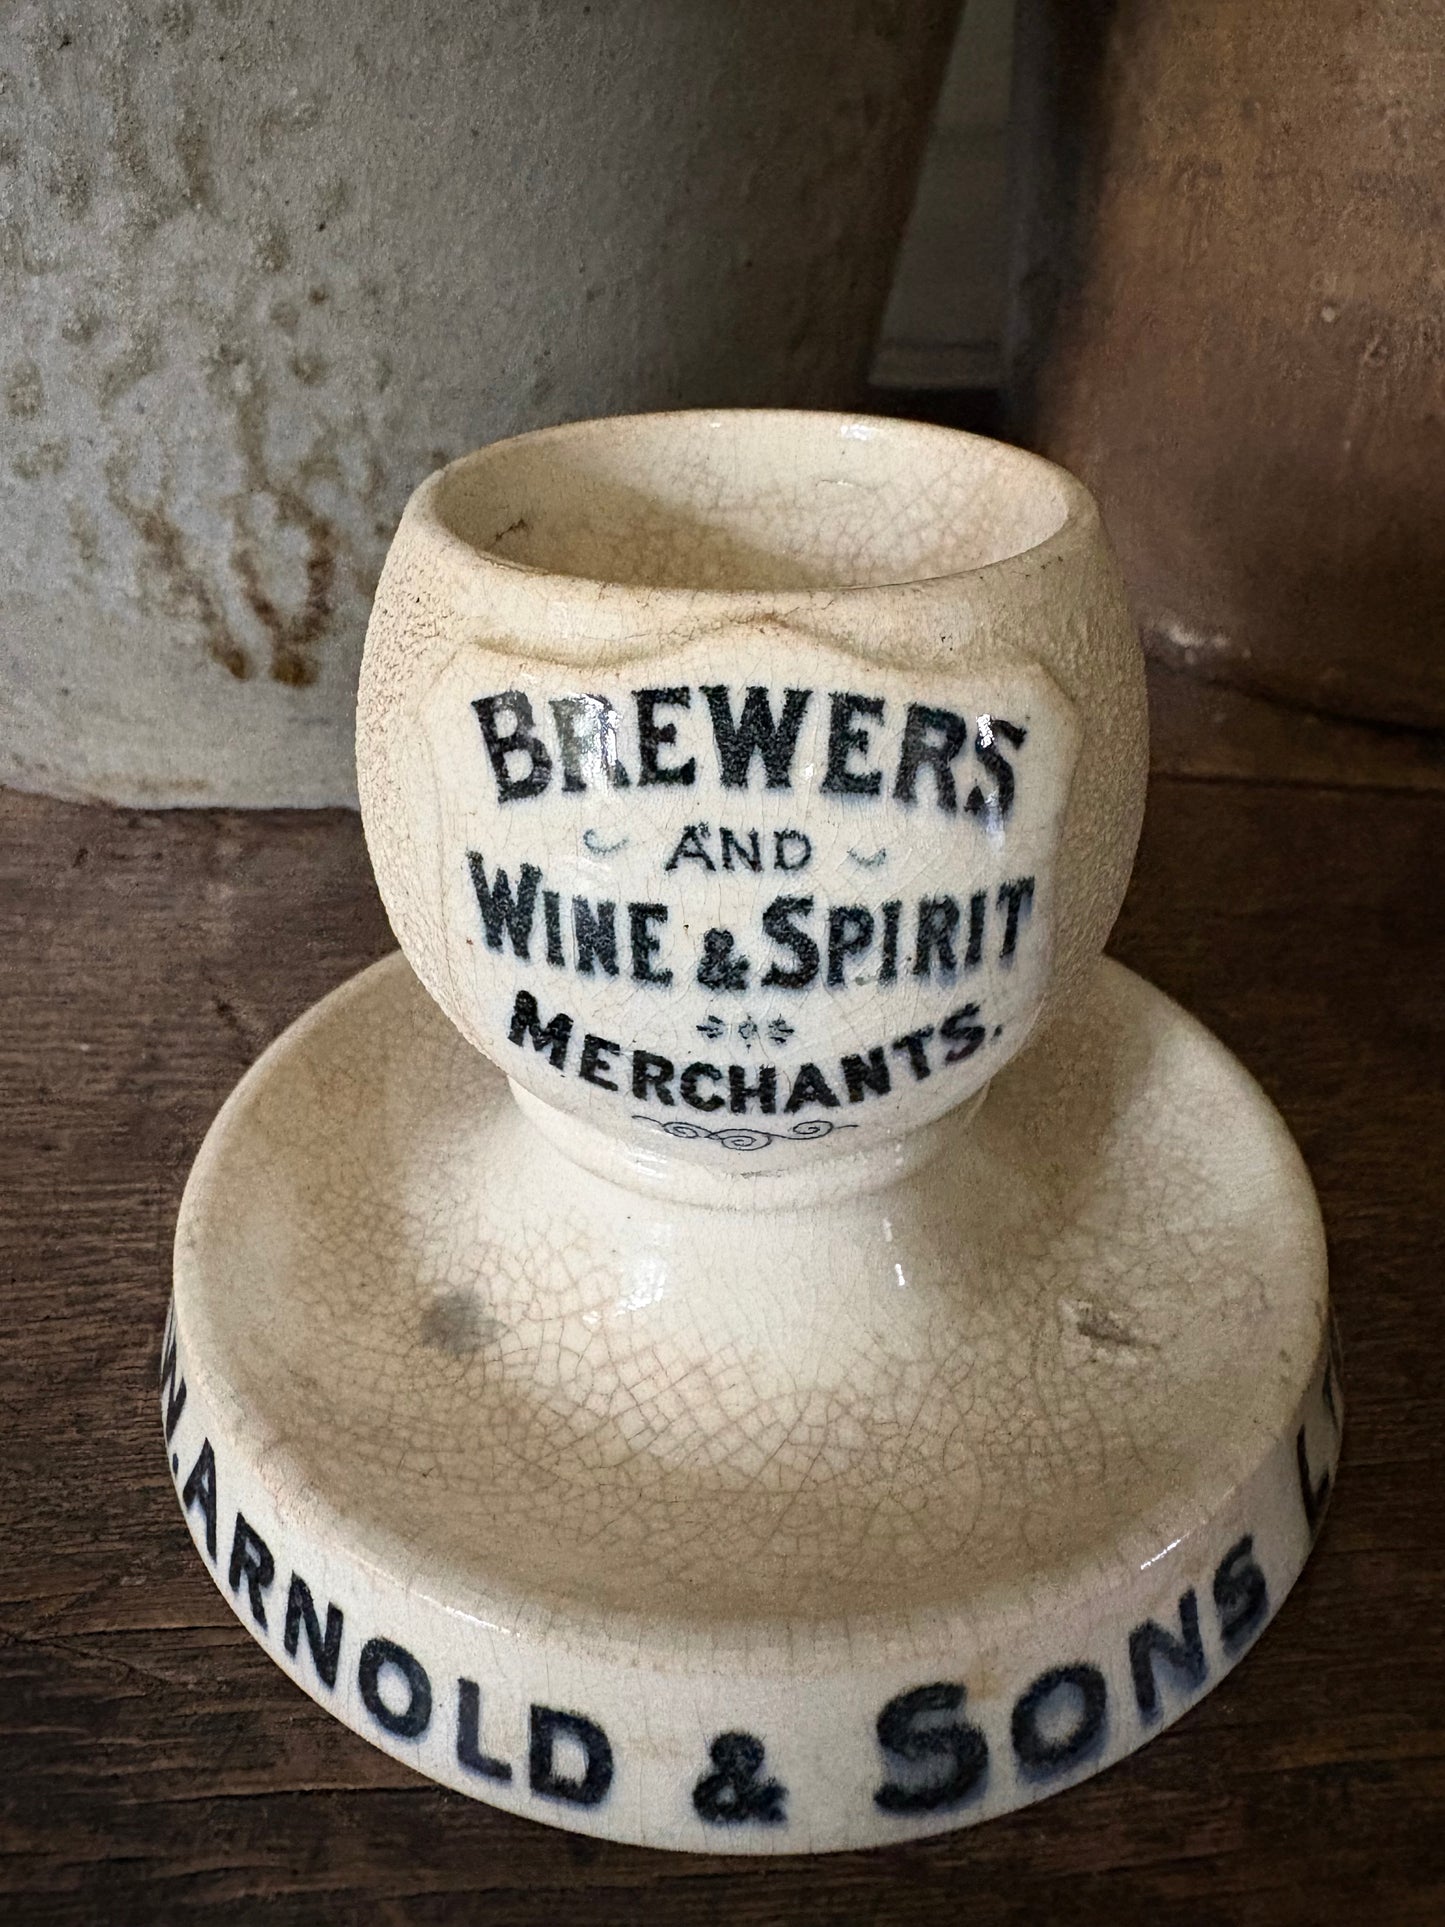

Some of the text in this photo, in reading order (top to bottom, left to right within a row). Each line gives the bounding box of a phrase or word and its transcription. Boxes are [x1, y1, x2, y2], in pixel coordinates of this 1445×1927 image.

[471, 684, 1027, 818] BREWERS
[665, 821, 812, 872] AND
[465, 850, 1035, 990] WINE & SPIRIT
[507, 990, 1002, 1115] MERCHANTS.
[692, 1731, 786, 1824] &
[873, 1534, 1269, 1816] SONS
